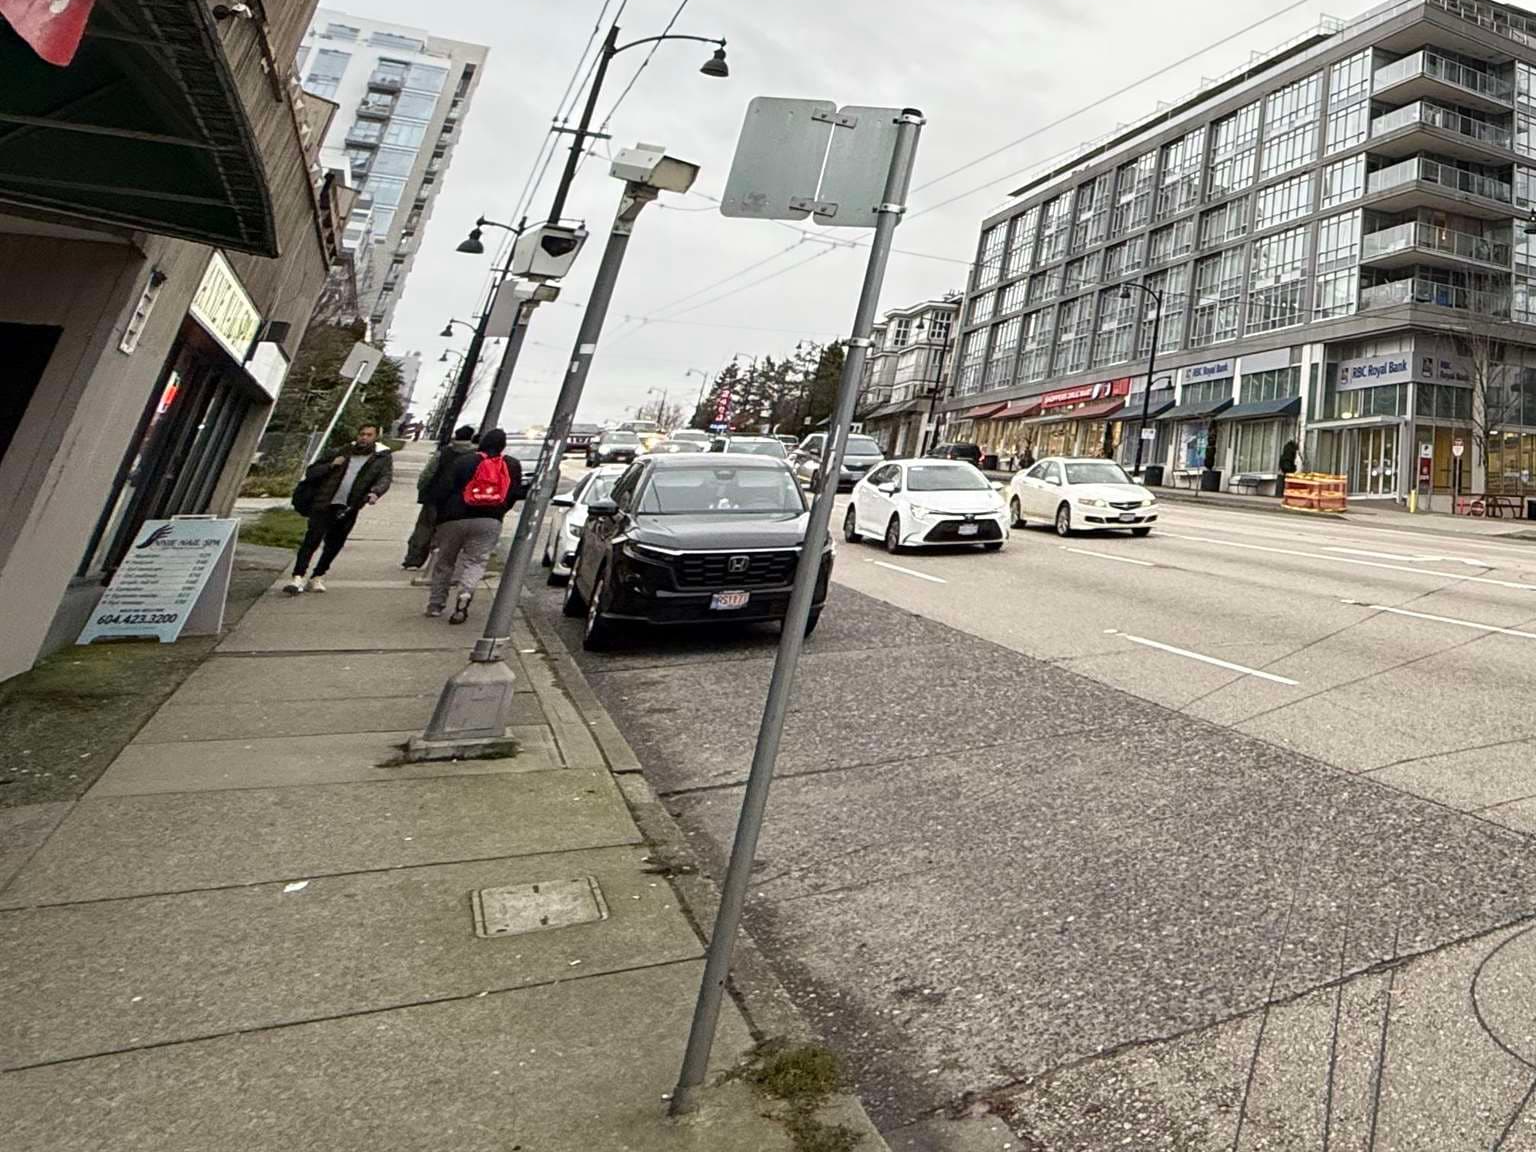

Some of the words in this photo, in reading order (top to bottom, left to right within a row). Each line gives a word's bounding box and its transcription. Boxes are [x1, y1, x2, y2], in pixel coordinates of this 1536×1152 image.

[1352, 366, 1366, 378] RBC
[1368, 362, 1387, 378] Royal
[1388, 359, 1407, 374] Bank
